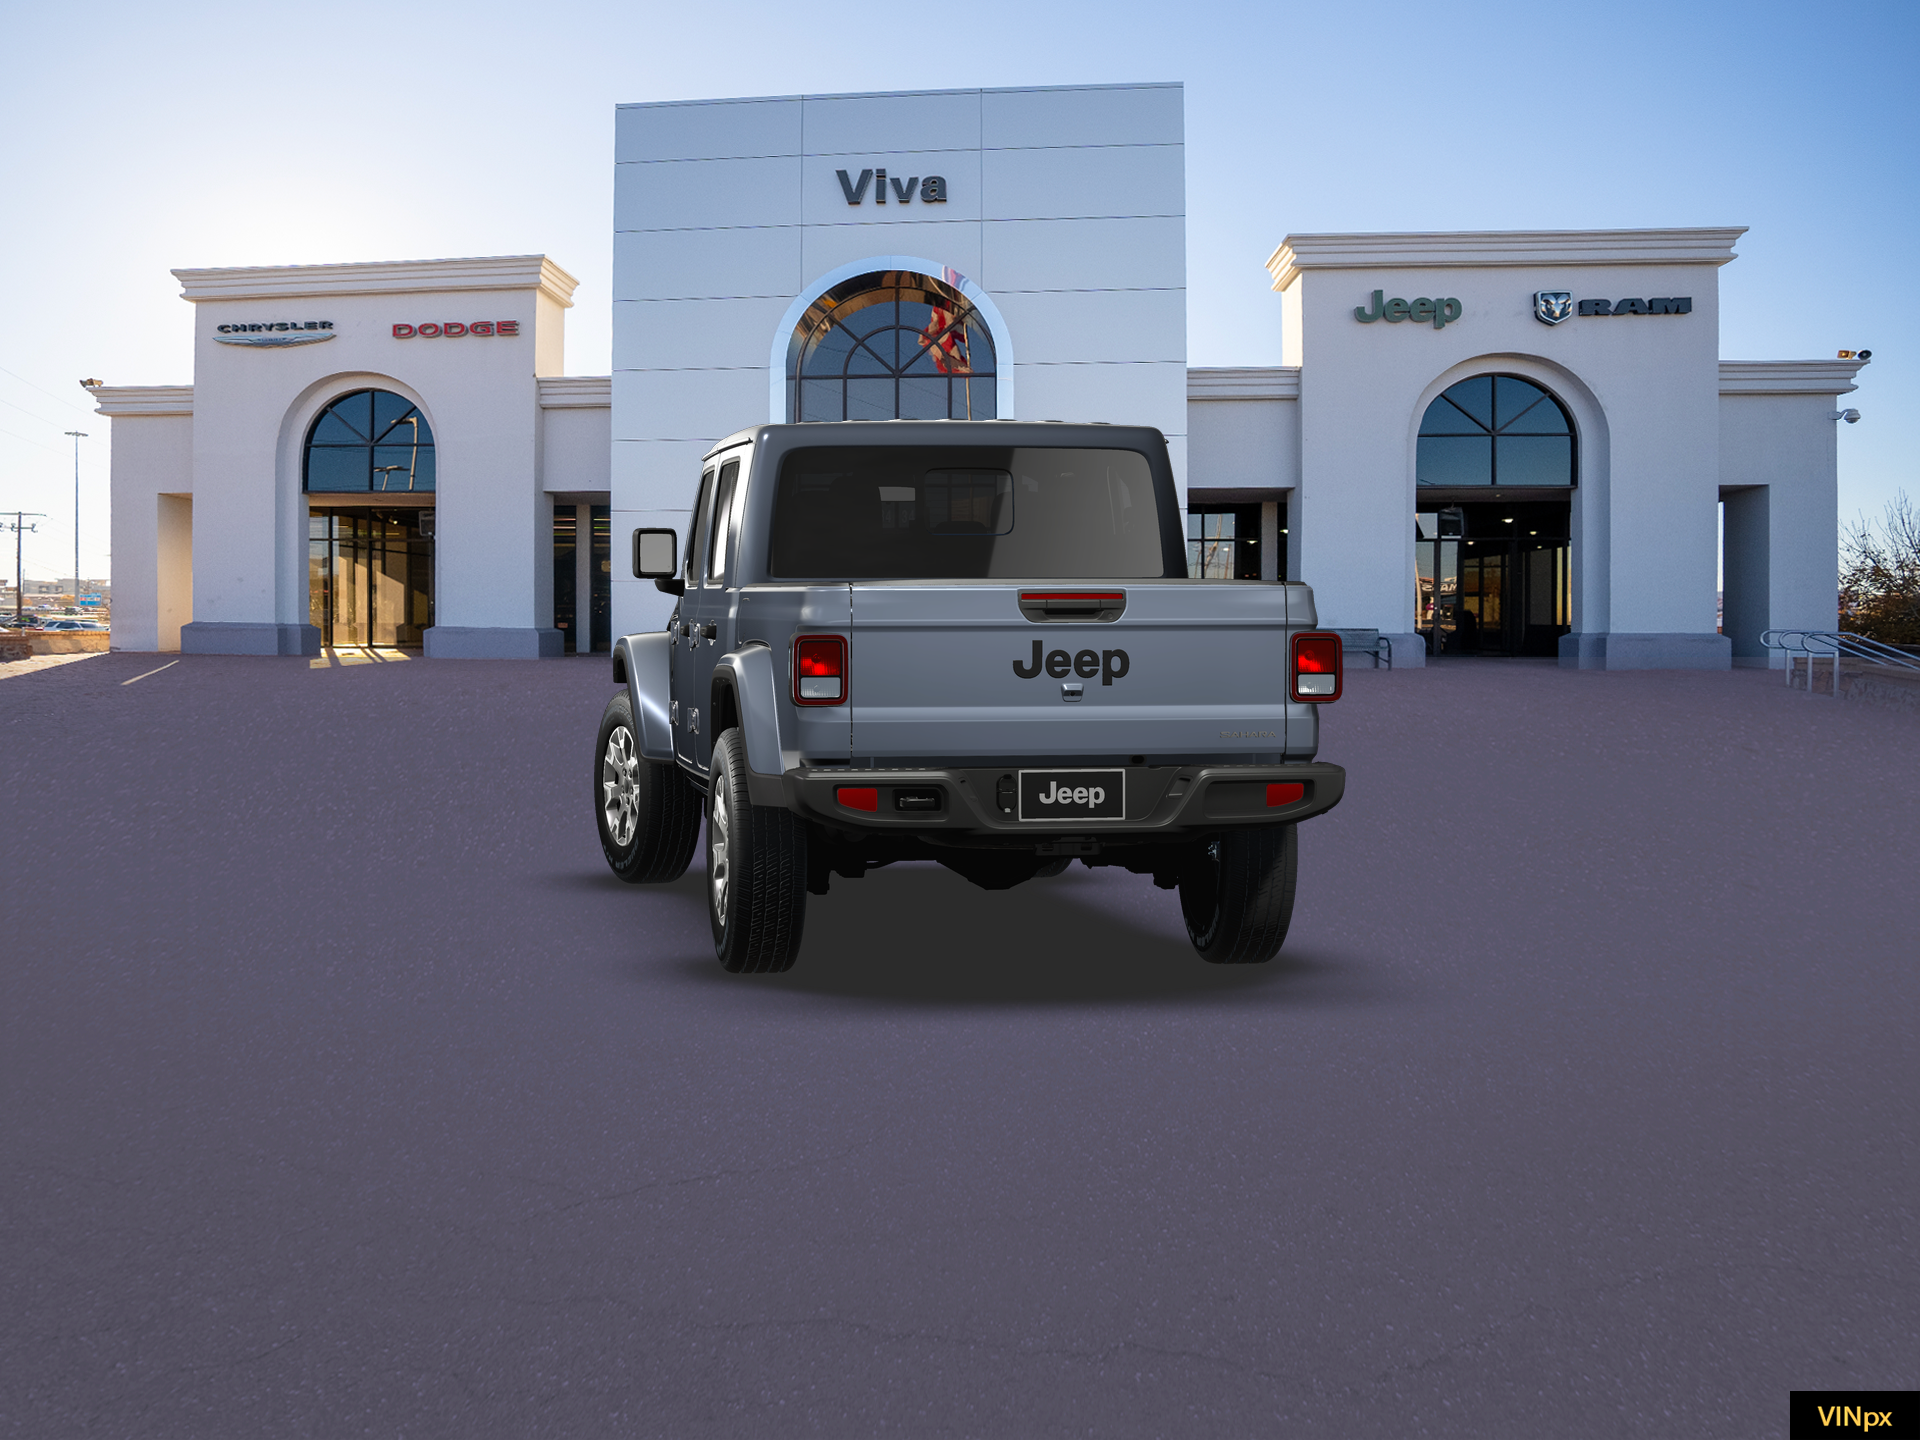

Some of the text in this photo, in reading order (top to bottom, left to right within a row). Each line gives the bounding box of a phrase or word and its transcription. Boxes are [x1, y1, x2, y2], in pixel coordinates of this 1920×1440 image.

[835, 168, 947, 205] Viva
[1354, 289, 1462, 329] Jeep
[1578, 297, 1692, 316] RAM
[217, 321, 333, 333] CHRYSLER
[392, 320, 519, 338] DODGE
[1013, 640, 1129, 686] Jeep
[1039, 781, 1105, 808] Jeep
